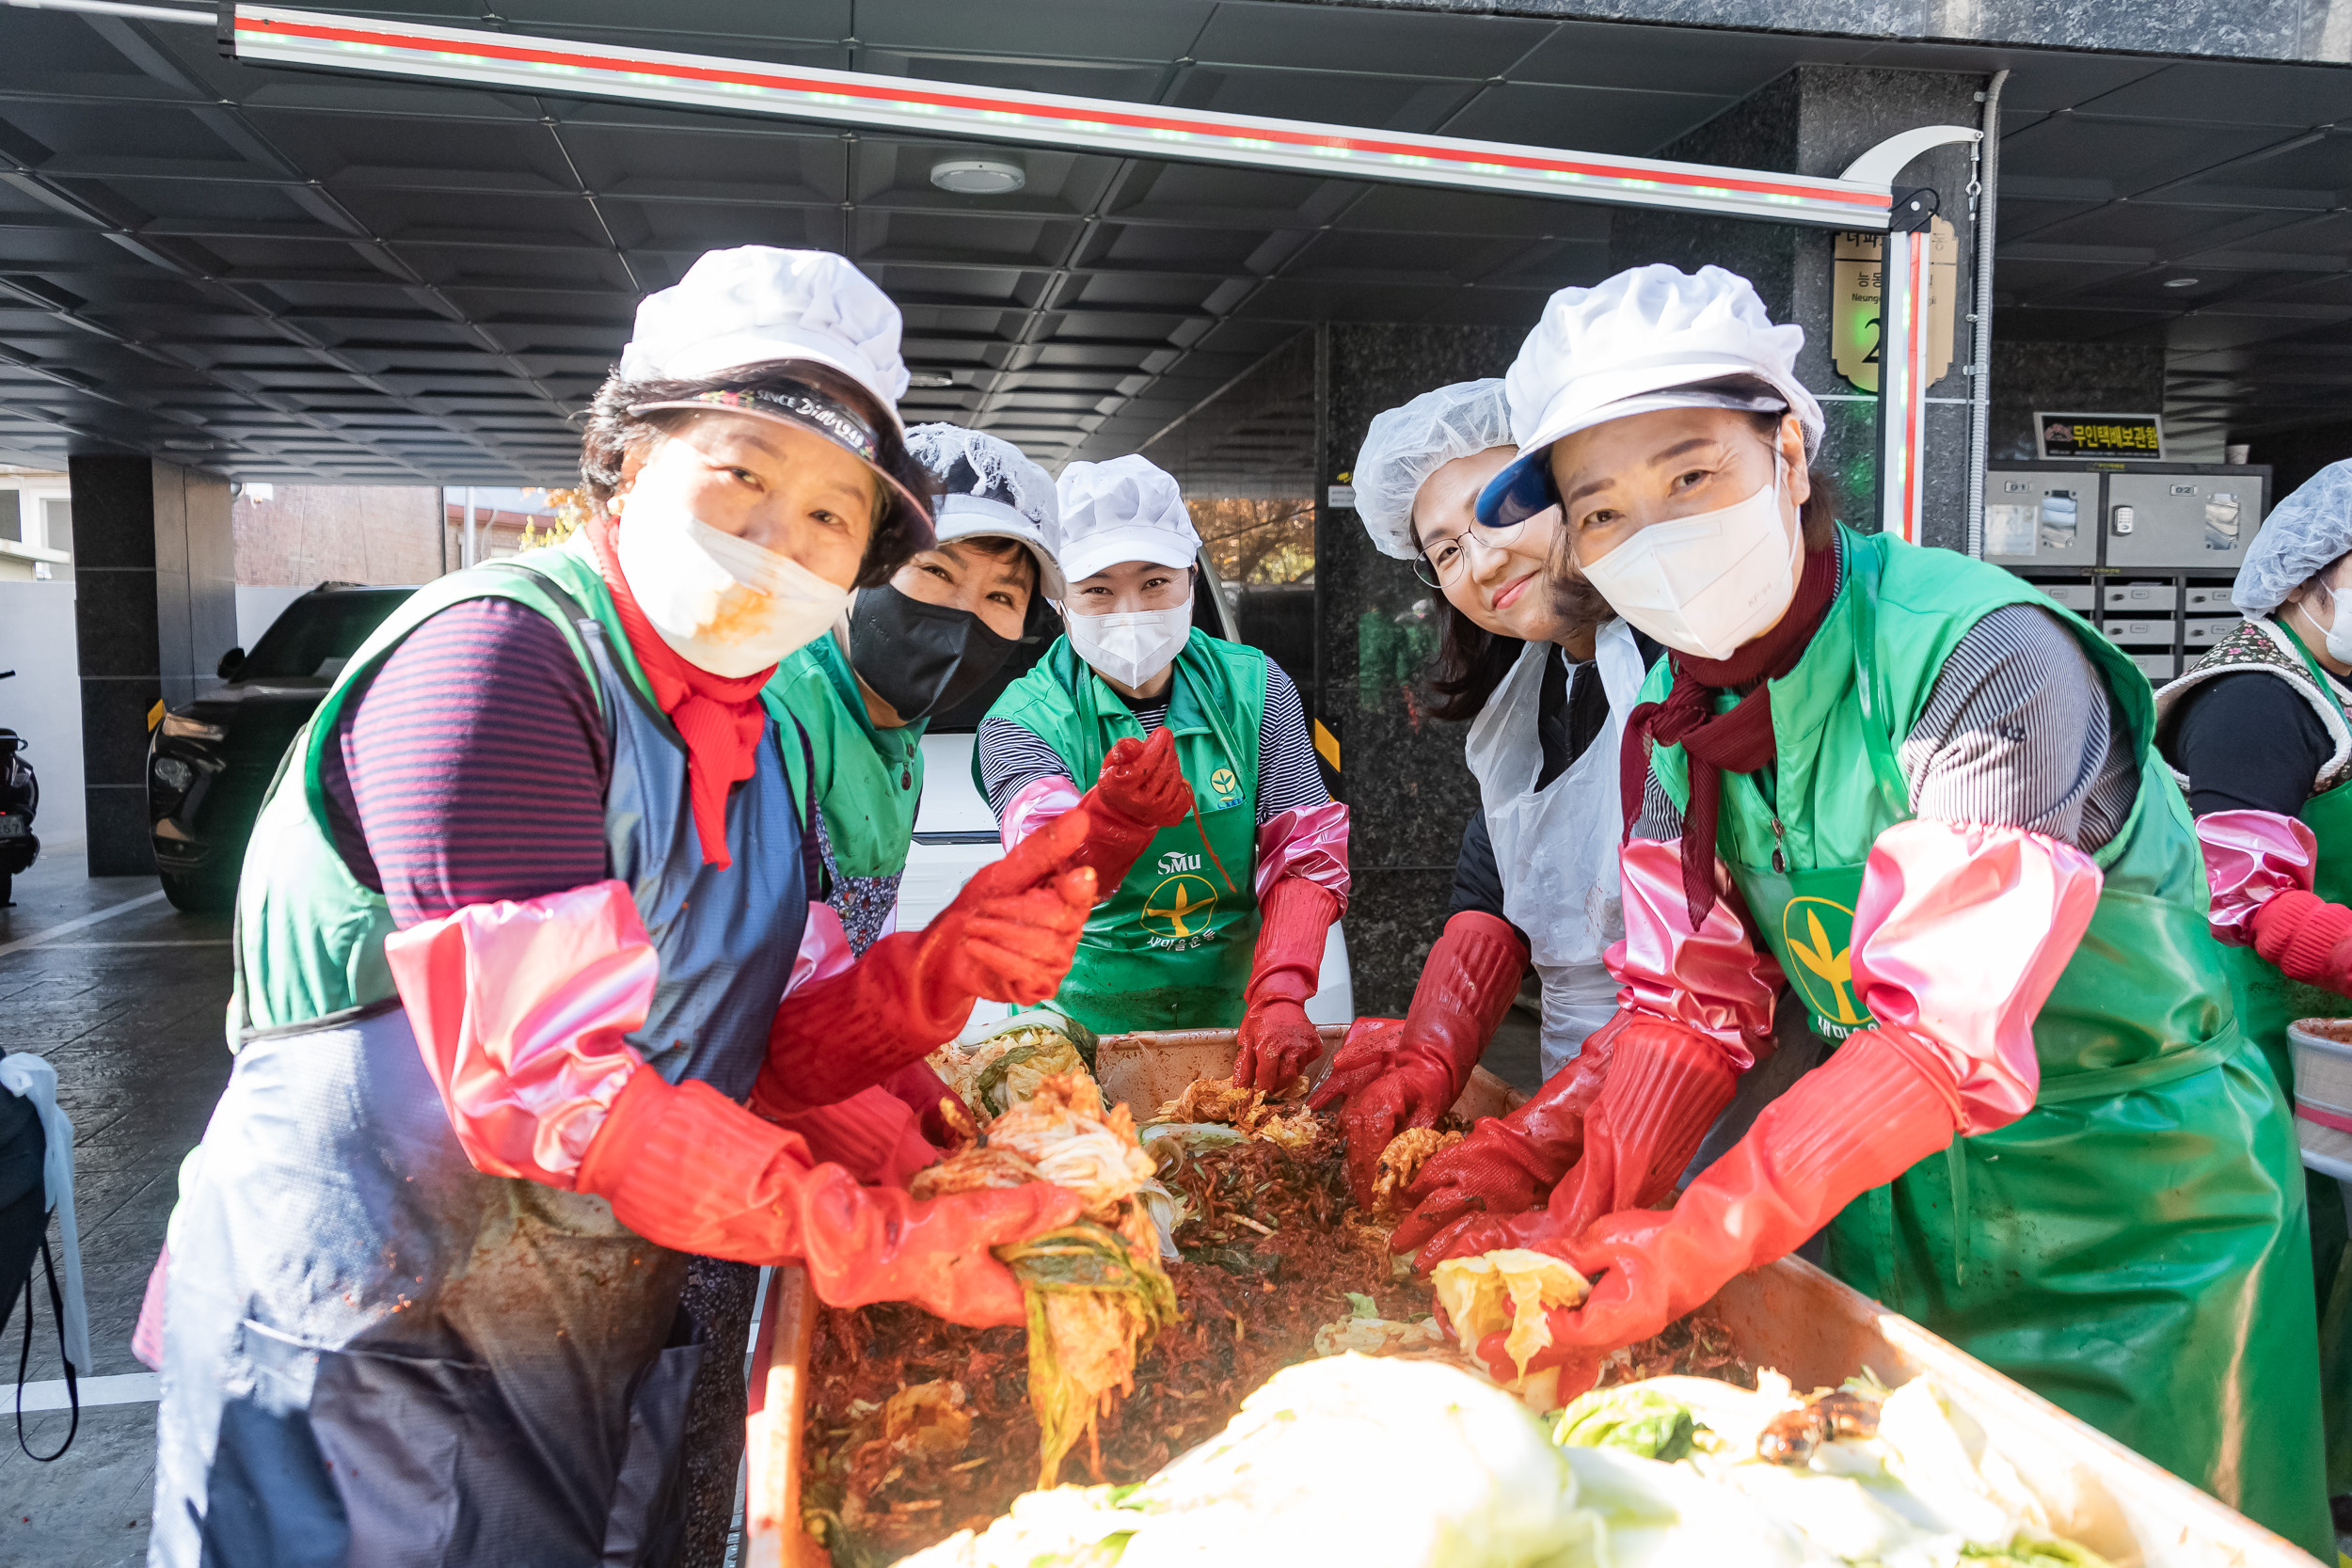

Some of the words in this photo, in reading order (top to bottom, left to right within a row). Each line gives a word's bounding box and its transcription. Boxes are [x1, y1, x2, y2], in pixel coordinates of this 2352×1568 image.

[755, 388, 797, 408] SINCE
[2073, 424, 2159, 450] 무인택배보관함
[2175, 485, 2192, 494] 02
[1157, 853, 1202, 876] SMU
[1146, 927, 1216, 952] 새마을운동
